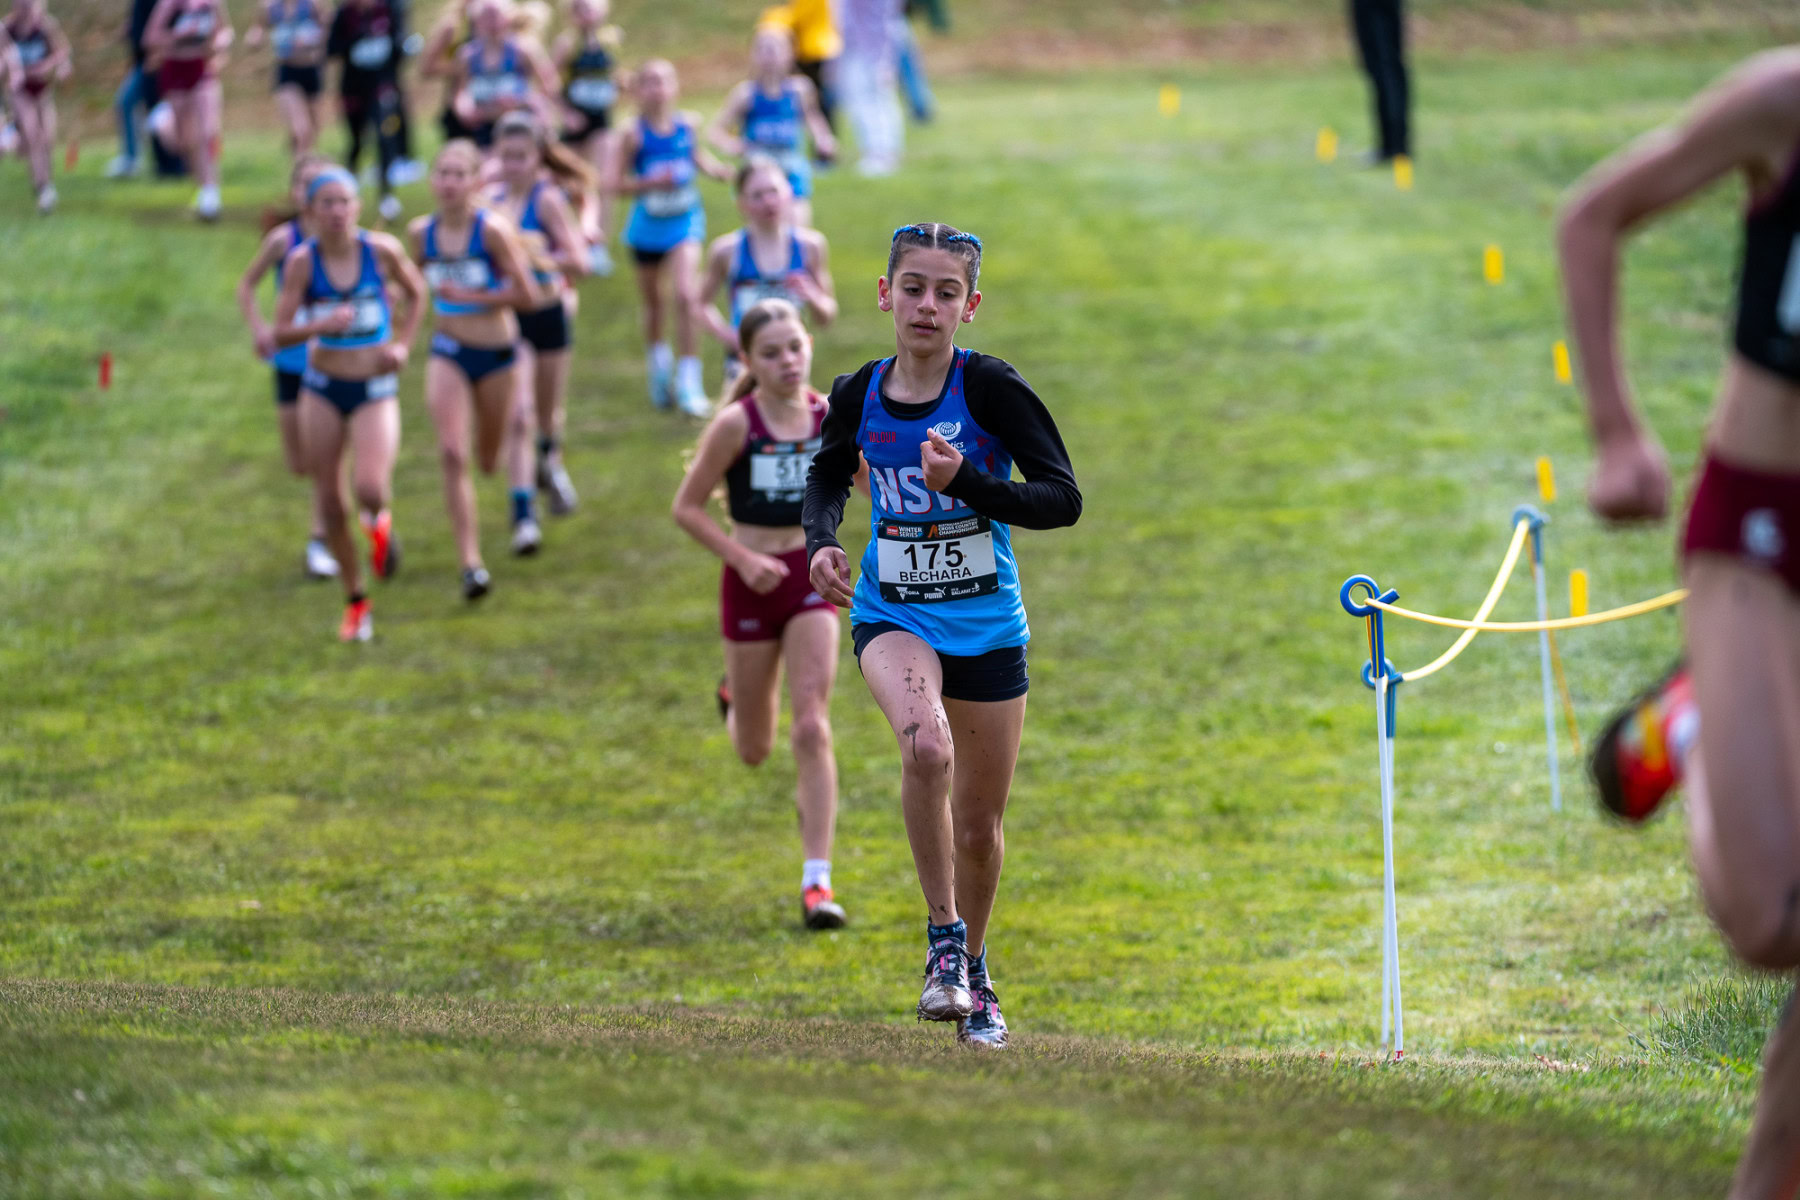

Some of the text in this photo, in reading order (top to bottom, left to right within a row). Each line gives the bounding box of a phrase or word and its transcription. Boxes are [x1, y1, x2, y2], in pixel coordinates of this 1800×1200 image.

[868, 431, 896, 443] VALOUR
[776, 455, 812, 479] 51
[938, 526, 979, 536] CHAMPIONSHIPS
[955, 521, 978, 530] COUNTRY
[904, 541, 963, 570] 175
[899, 567, 972, 582] BECHARA
